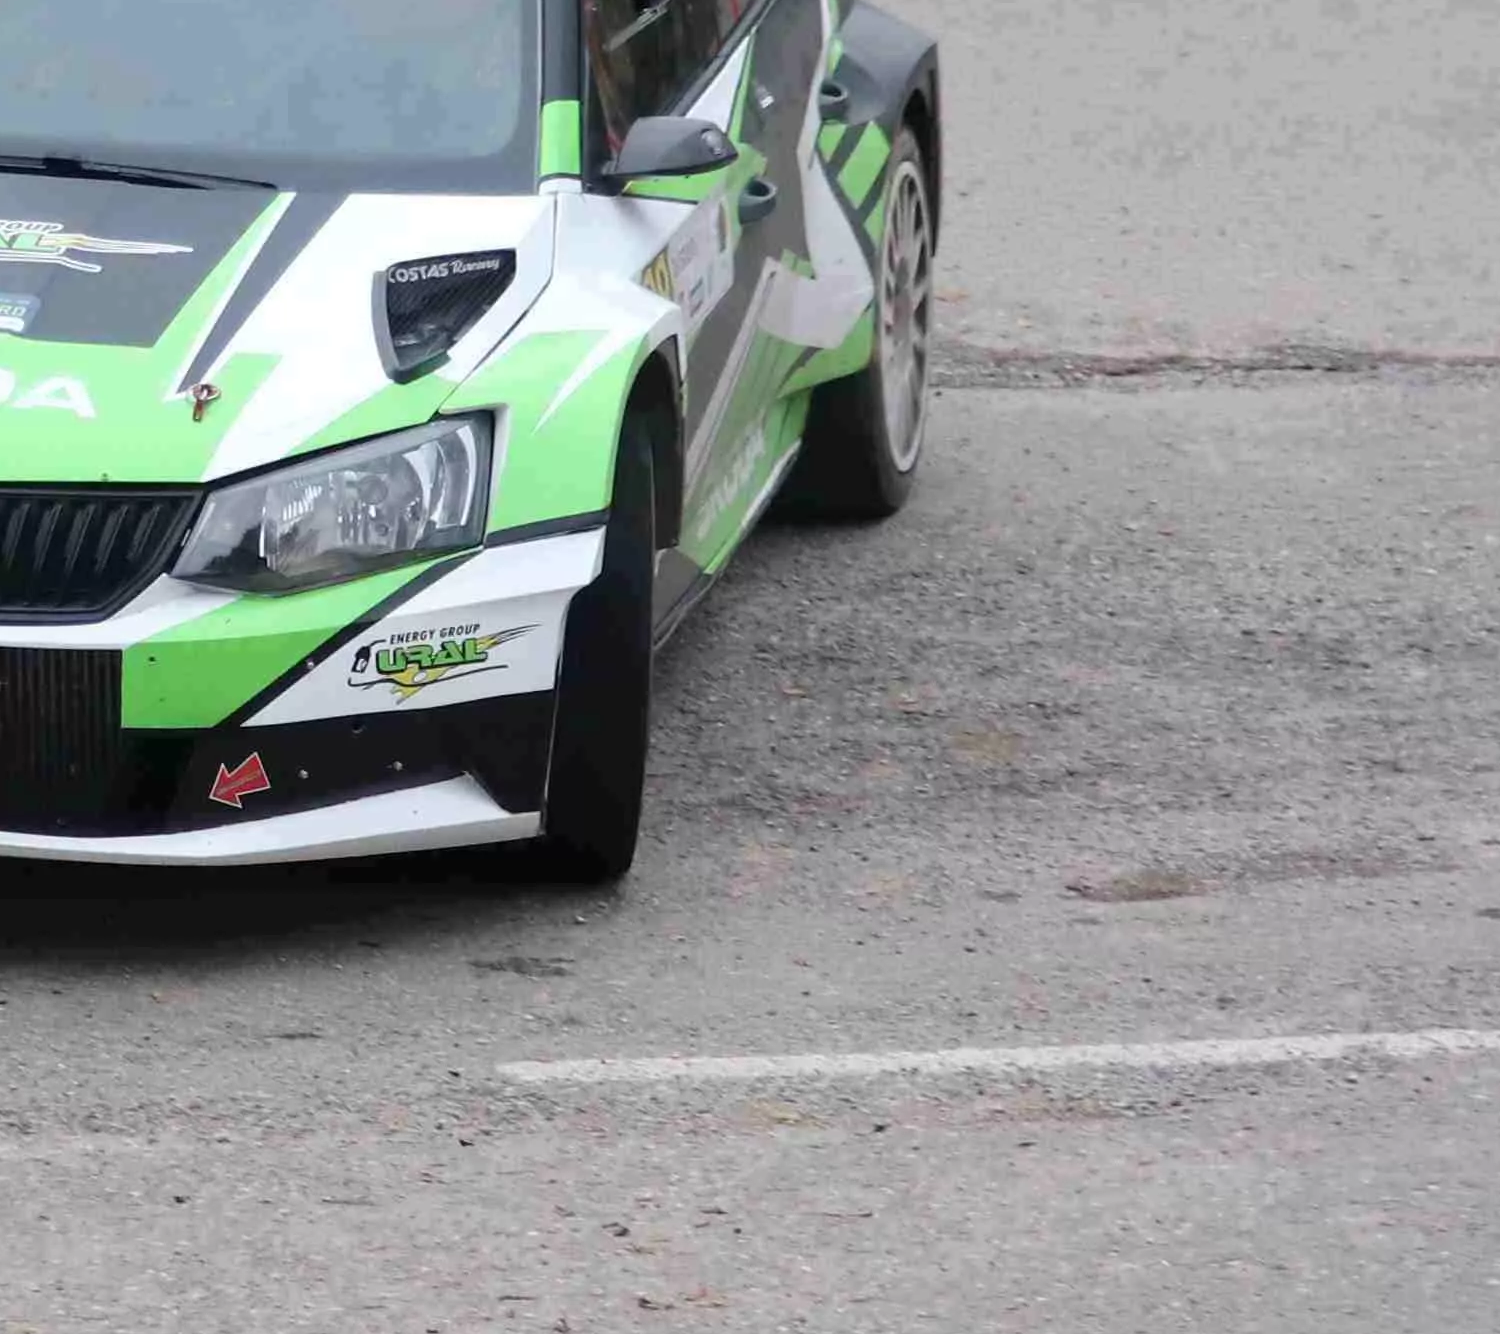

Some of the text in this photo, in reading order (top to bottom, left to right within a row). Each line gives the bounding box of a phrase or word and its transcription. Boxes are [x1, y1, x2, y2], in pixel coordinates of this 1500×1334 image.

[387, 262, 450, 284] COSTAS
[389, 623, 481, 646] ENERGY GROUP
[376, 637, 489, 676] URAL
